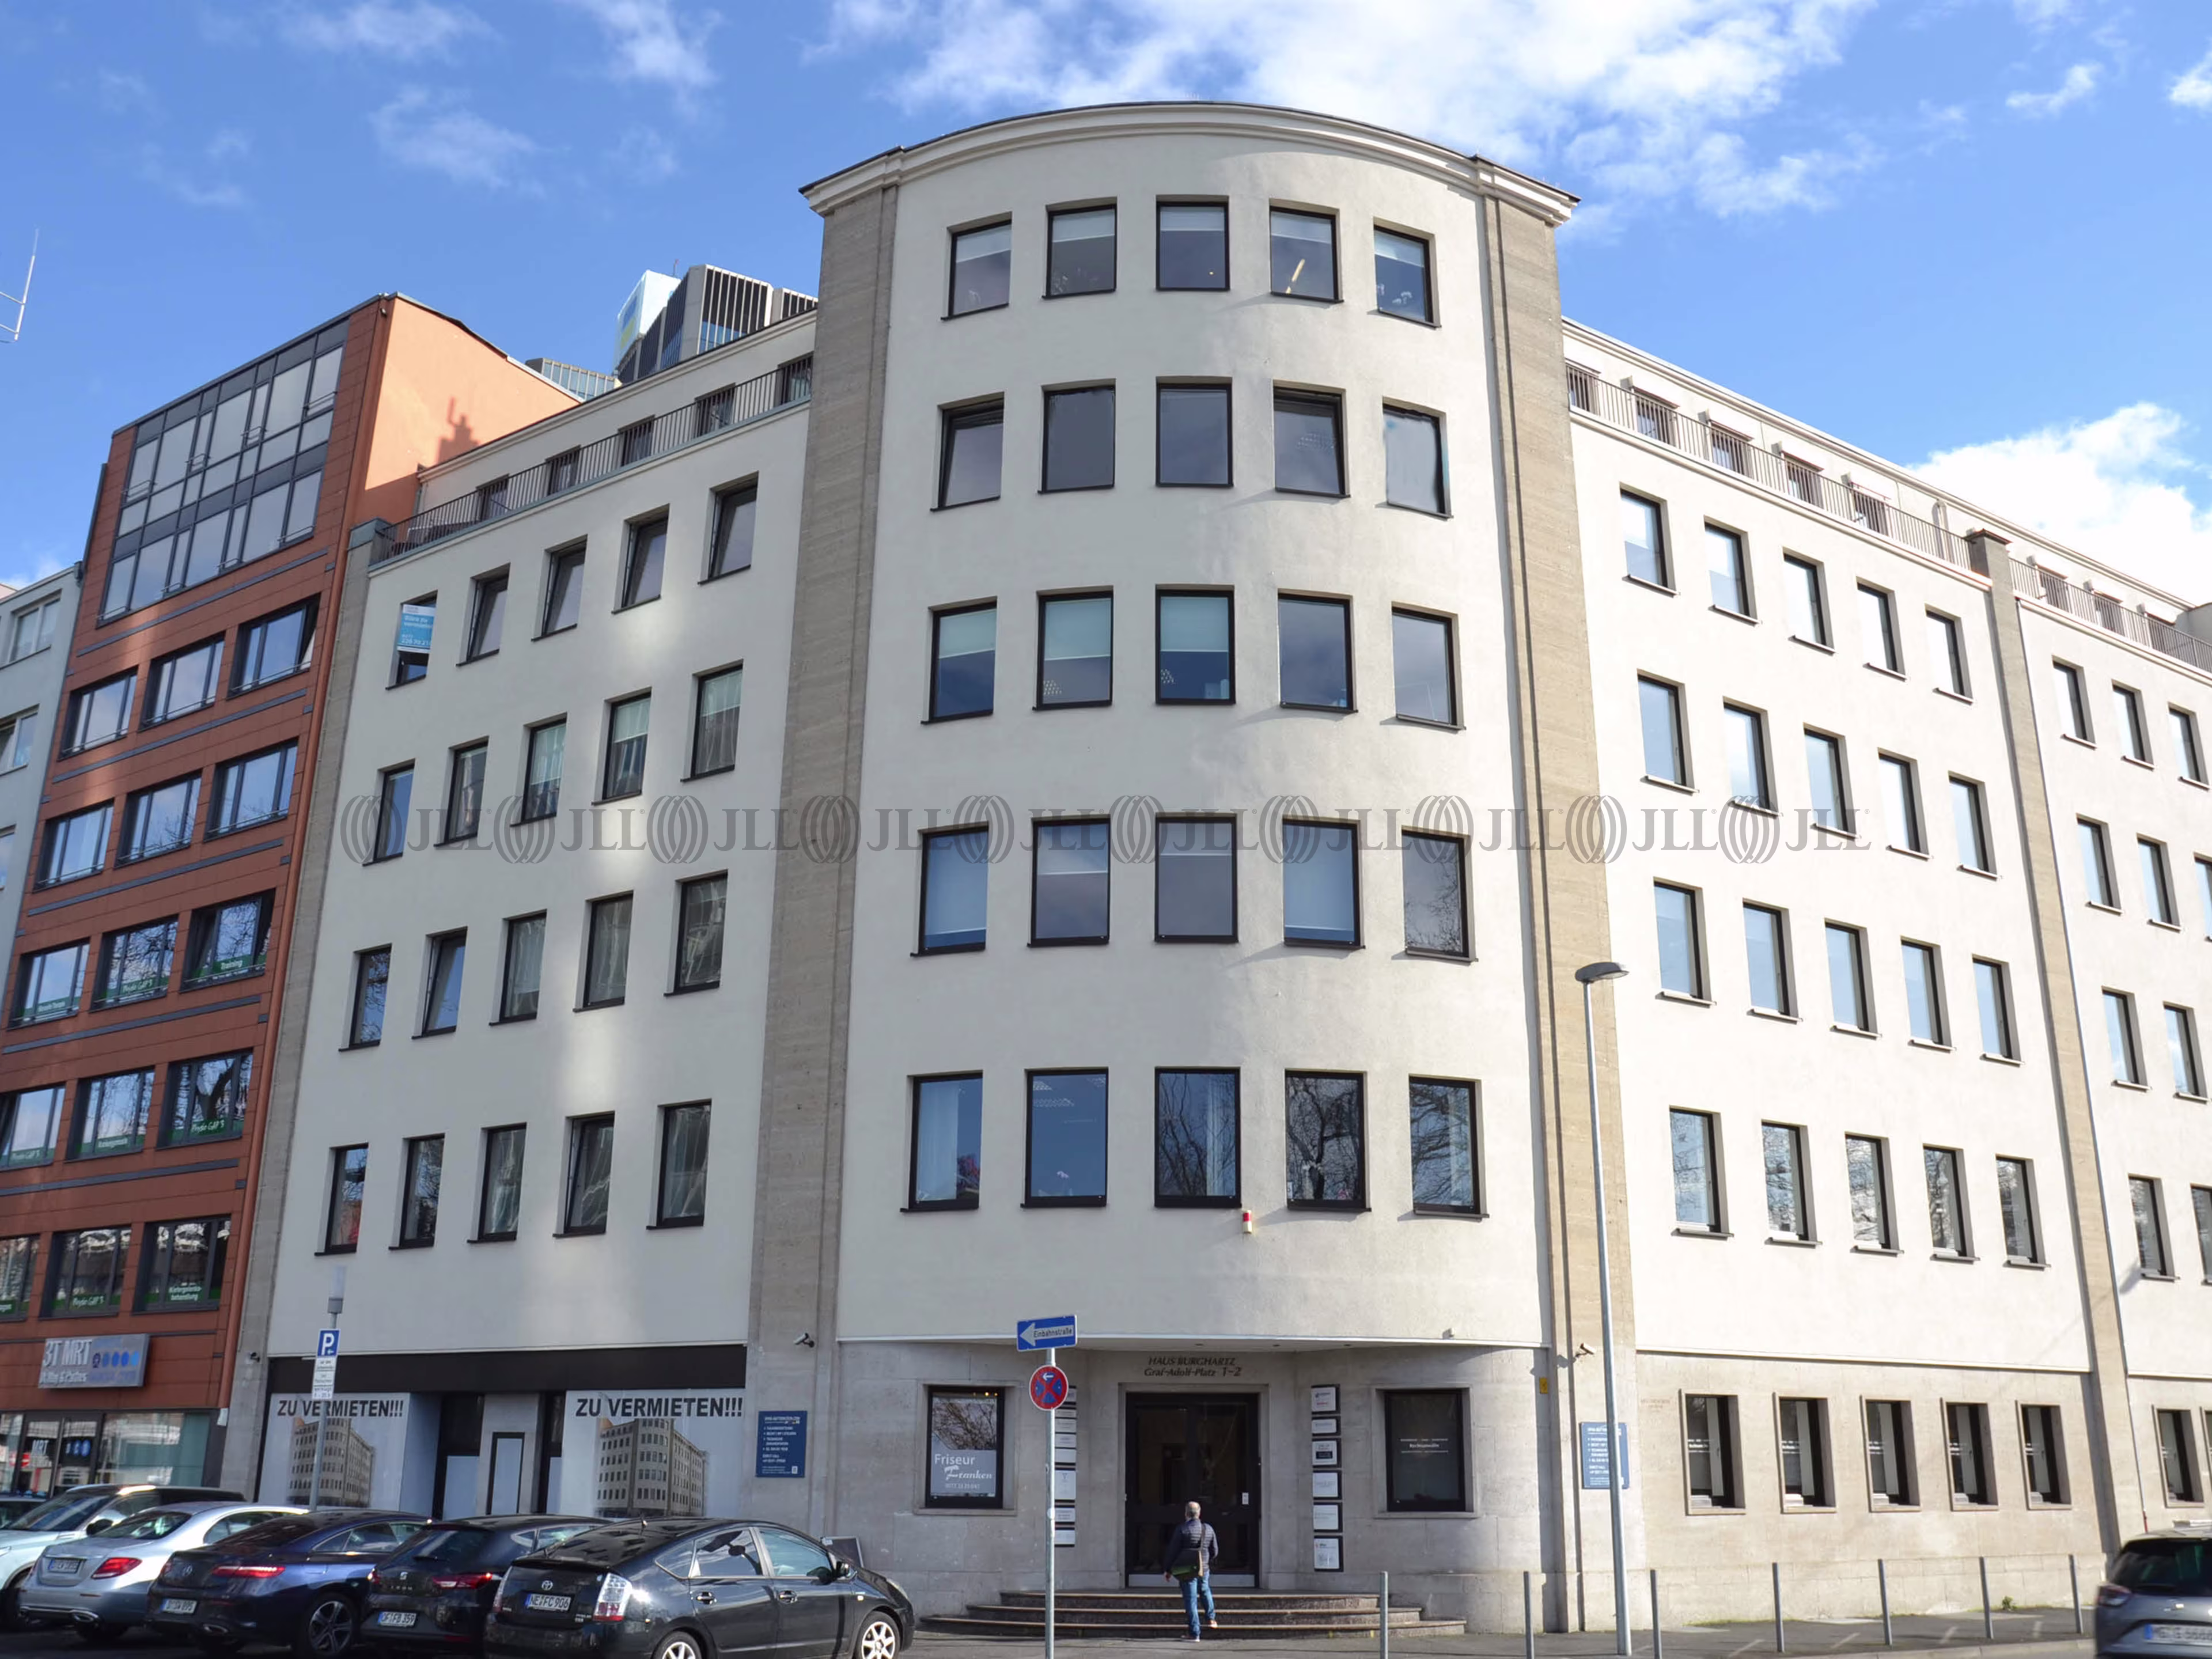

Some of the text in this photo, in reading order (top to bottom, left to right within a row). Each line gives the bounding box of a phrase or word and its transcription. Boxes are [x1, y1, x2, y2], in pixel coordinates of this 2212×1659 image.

[1033, 1327, 1072, 1338] Einbahnstraße
[62, 1339, 93, 1365] MRT
[321, 1333, 335, 1355] P
[1147, 1357, 1236, 1366] HAUS BURGHARTZ
[277, 1400, 297, 1416] ZU
[576, 1397, 743, 1417] ZU VERMIETEN!!!
[934, 1453, 975, 1465] Friseur
[944, 1464, 993, 1481] Franken
